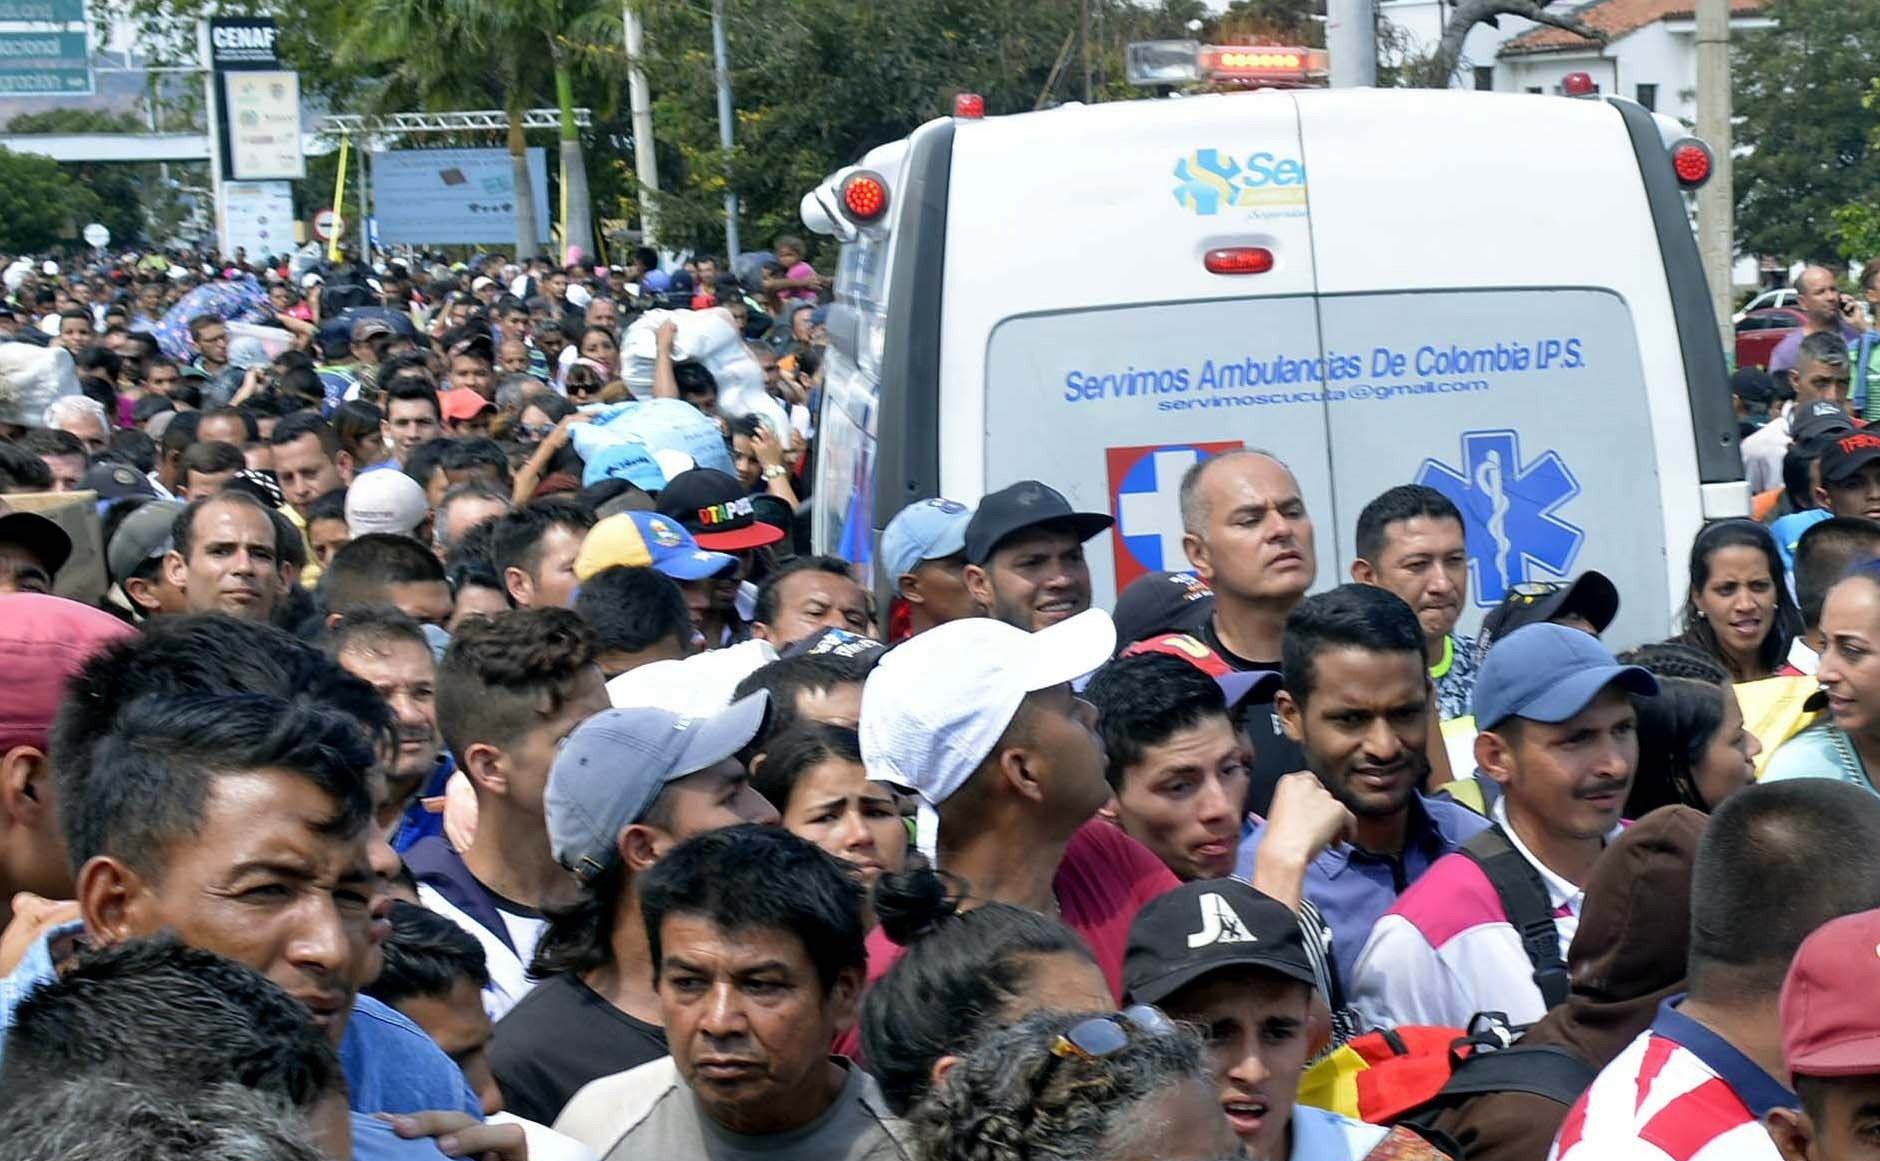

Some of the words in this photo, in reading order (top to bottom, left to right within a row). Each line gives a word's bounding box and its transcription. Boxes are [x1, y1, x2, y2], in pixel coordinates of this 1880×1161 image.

[212, 26, 276, 48] CENAF
[1064, 367, 1189, 402] Servimos
[1199, 352, 1362, 390] Ambulancias
[1371, 348, 1406, 377] De
[1415, 341, 1530, 376] Colombia
[1157, 378, 1490, 412] servimoscucuta@gmail.com
